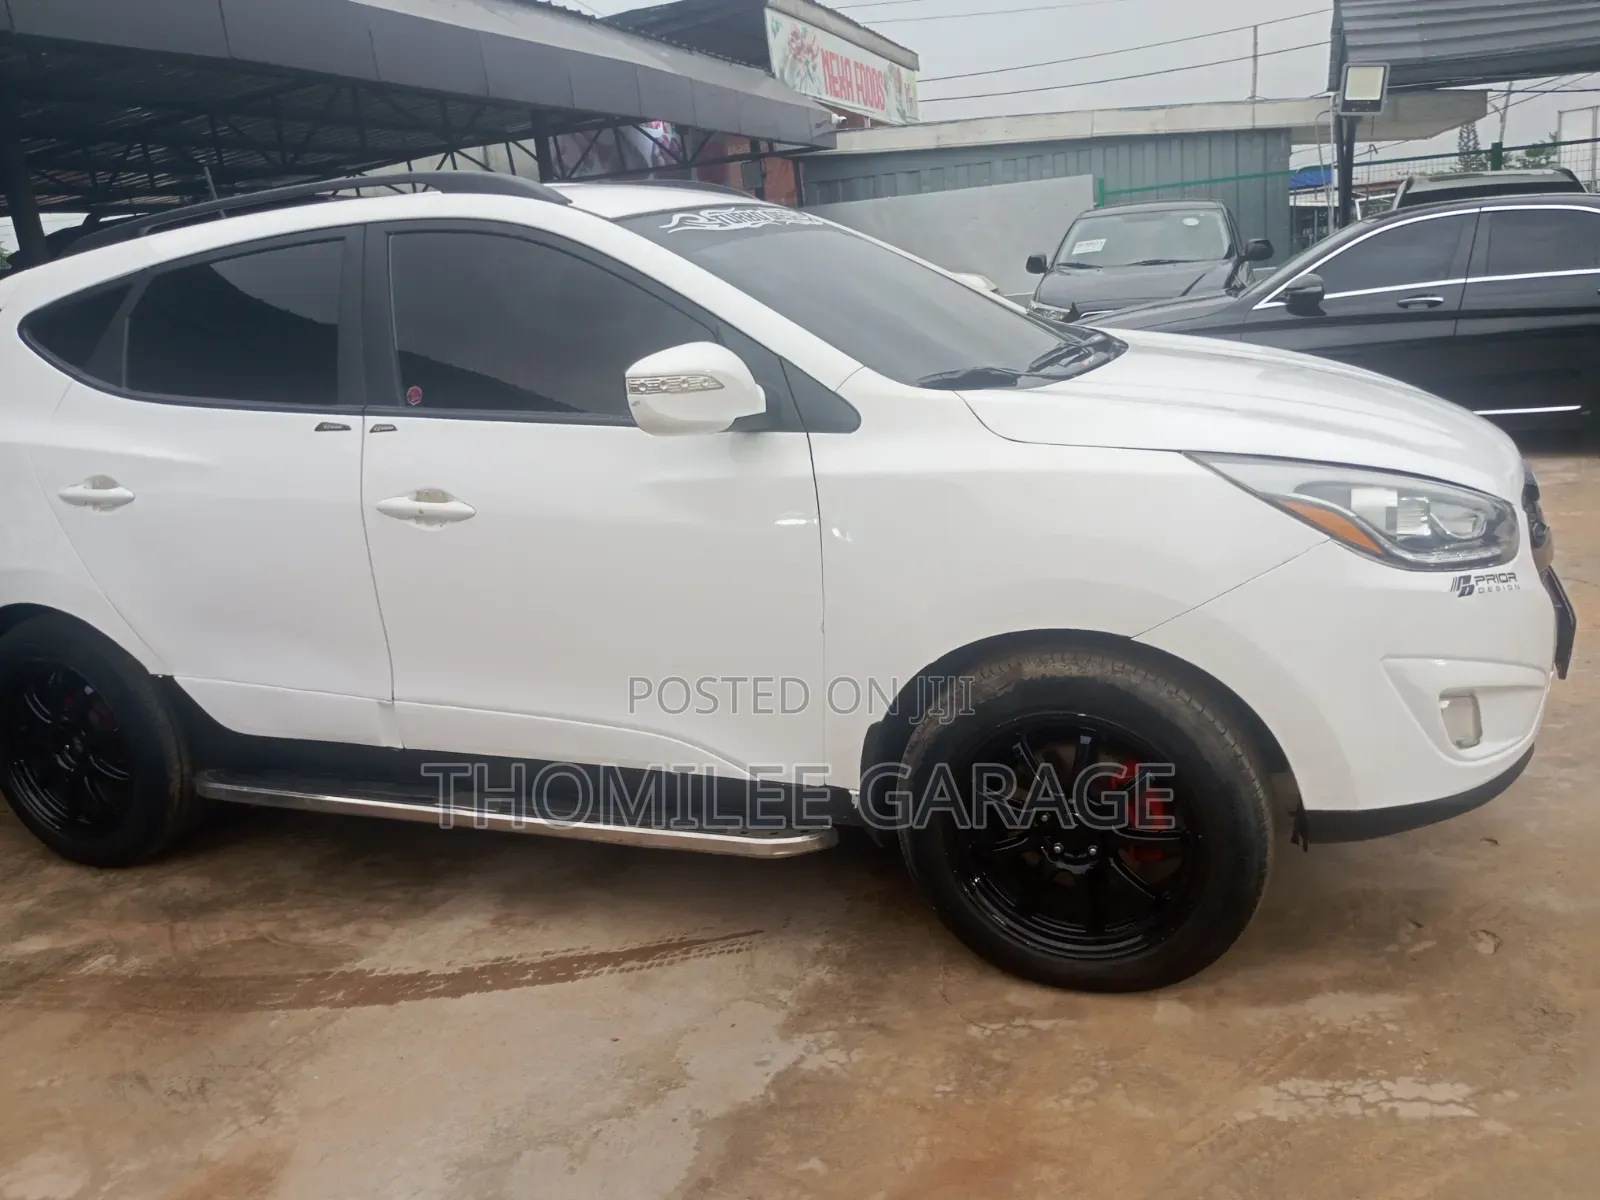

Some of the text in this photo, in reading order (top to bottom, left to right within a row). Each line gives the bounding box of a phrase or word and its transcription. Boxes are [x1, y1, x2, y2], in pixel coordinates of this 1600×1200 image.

[853, 60, 886, 111] FOODS
[1473, 572, 1518, 586] PRIOR
[1477, 584, 1521, 594] DESIGN
